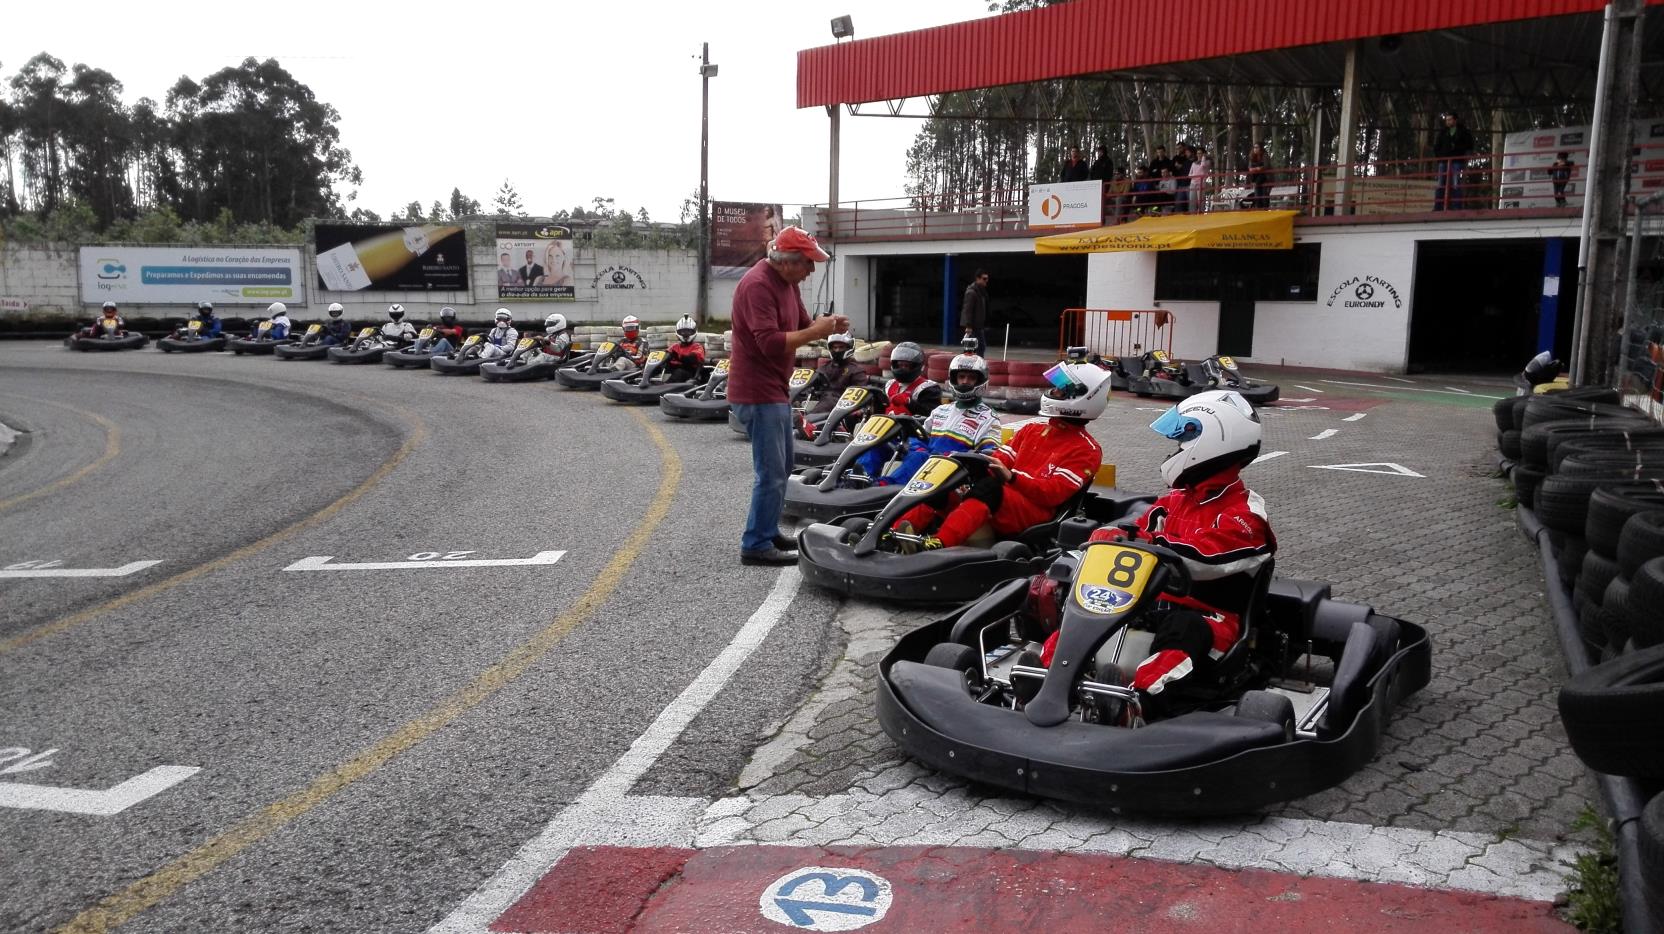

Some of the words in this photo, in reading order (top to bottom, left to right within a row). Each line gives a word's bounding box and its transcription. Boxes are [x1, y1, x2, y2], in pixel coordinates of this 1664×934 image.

[717, 207, 722, 215] O
[724, 208, 746, 216] MUSEU
[717, 215, 725, 223] DE
[1060, 241, 1171, 251] www.pestronix.pt
[1326, 276, 1360, 307] ESCOLA
[1365, 275, 1402, 309] KARTING
[1344, 300, 1385, 308] EUROINDY
[793, 369, 811, 380] 22
[842, 388, 865, 400] 29
[868, 417, 889, 435] 11
[920, 459, 942, 481] 4
[407, 550, 477, 561] 20
[1107, 550, 1143, 588] 8
[1089, 588, 1111, 601] 24
[773, 872, 880, 927] 13
